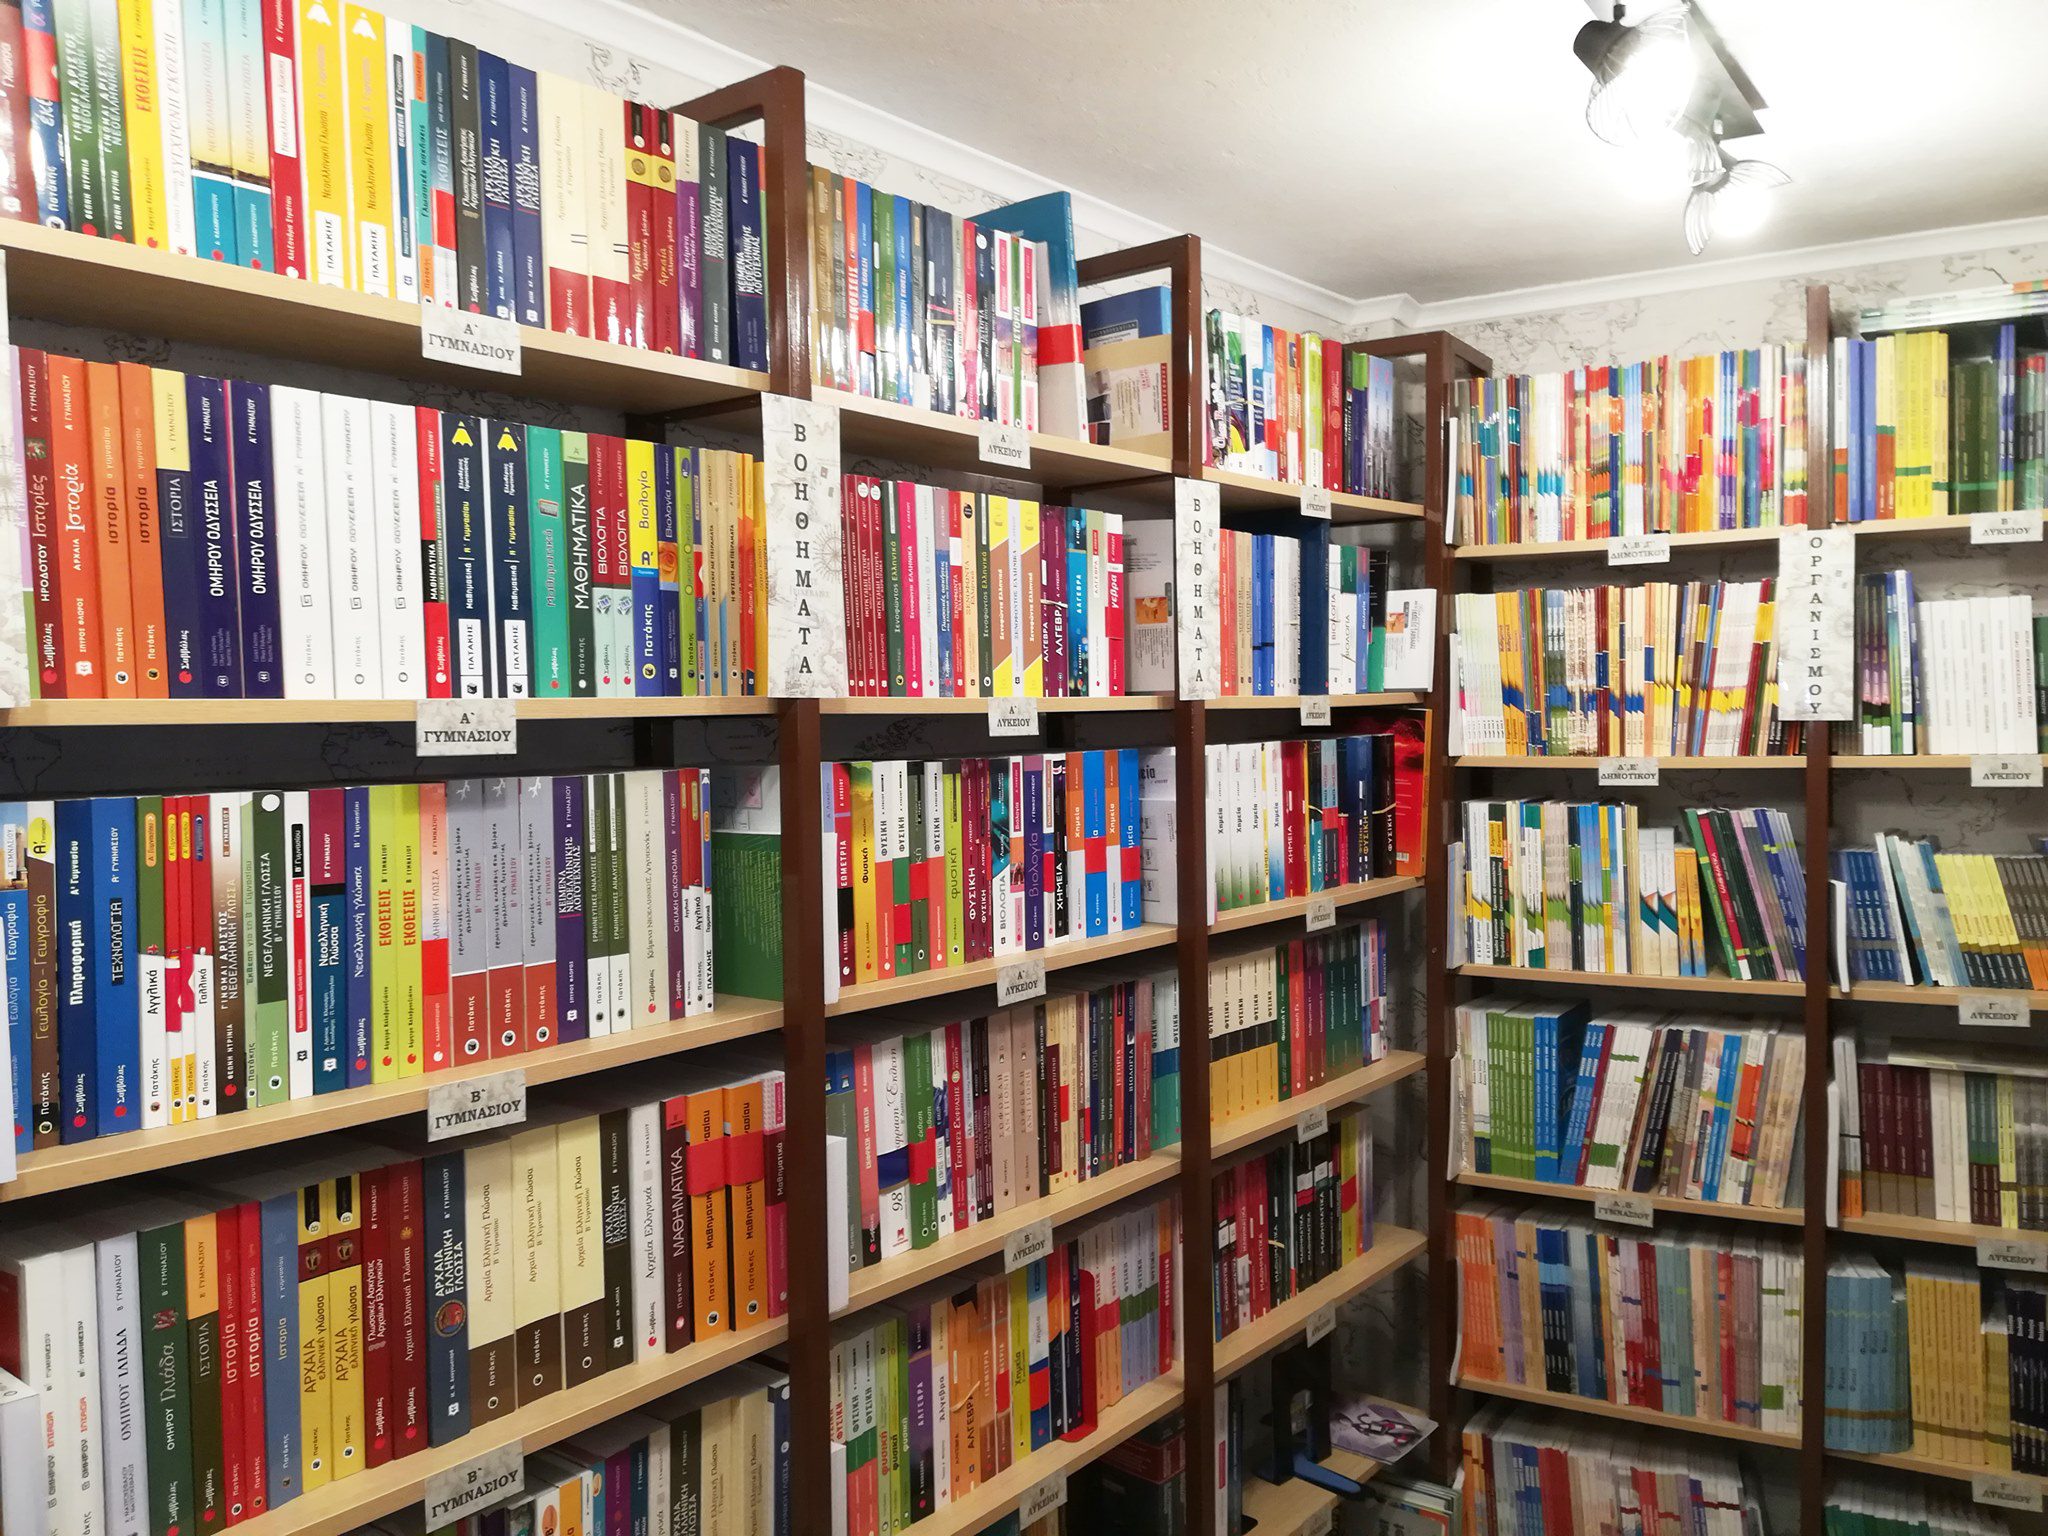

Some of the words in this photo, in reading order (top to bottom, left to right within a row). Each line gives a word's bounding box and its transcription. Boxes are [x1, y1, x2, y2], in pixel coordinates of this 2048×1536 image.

[132, 47, 151, 112] ΕΚΘΕΣΕΙΣ
[323, 219, 334, 269] ΠΑΤΑΚΗΣ
[369, 228, 380, 279] ΠΑΤΑΚΗΣ
[752, 236, 762, 295] ΛΟΓΟΤΕΧΝΙΑΣ
[737, 252, 745, 292] ΚΕΙΜΕΝΑ
[848, 267, 858, 320] ΕΚΘΕΣΕΙΣ
[429, 332, 515, 362] ΓΥΜΝΑΣΙΟΥ
[202, 397, 211, 434] ΓΥΜΝΑΣΙΟΥ
[248, 399, 256, 435] ΓΥΜΝΑΣΙΟΥ
[988, 445, 1022, 459] ΛΥΚΕΙΟΥ
[31, 475, 47, 538] Ιστορίες
[60, 463, 85, 532] Ιστορία
[104, 487, 119, 544] ιστορία
[136, 487, 150, 543] ιστορία
[169, 478, 183, 532] ΙΣΤΟΡΙΑ
[204, 480, 220, 539] ΟΔΥΣΣΕΙΑ
[248, 480, 264, 538] ΟΔΥΣΣΕΙΑ
[638, 470, 650, 528] Βιολογία
[665, 490, 673, 537] Βιολογία
[571, 484, 590, 609] ΜΑΘΗΜΑΤΙΚΑ
[597, 507, 608, 574] ΒΙΟΛΟΓΙΑ
[618, 509, 628, 576] ΒΙΟΛΟΓΙΑ
[794, 423, 812, 674] ΒΟΗΘΗΜΑΤΑ
[1610, 548, 1667, 559] ΔΗΜΟΤΙΚΟΥ
[1982, 526, 2030, 536] ΛΥΚΕΙΟΥ
[38, 544, 50, 601] ΗΡΟΔΟΤΟΥ
[208, 542, 224, 596] ΟΜΗΡΟΥ
[251, 541, 266, 594] ΟΜΗΡΟΥ
[428, 544, 437, 600] ΜΑΘΗΜΑΤΙΚΑ
[889, 540, 899, 581] Ελληνικά
[1193, 498, 1203, 682] ΒΟΗΘΗΜΑΤΑ
[146, 625, 156, 659] Πατάκης
[512, 625, 520, 670] ΠΑΤΑΚΗΣ
[643, 604, 654, 657] Πατάκης
[1808, 537, 1823, 714] ΟΡΓΑΝΙΣΜΟΥ
[578, 638, 586, 674] Πατάκης
[424, 728, 511, 743] ΓΥΜΝΑΣΙΟΥ
[997, 718, 1030, 728] ΛΥΚΕΙΟΥ
[1982, 772, 2032, 781] ΛΥΚΕΙΟΥ
[110, 827, 119, 872] ΓΥΜΝΑΣΙΟΥ
[323, 833, 331, 869] ΓΥΜΝΑΣΙΟΥ
[880, 820, 888, 856] ΦΥΣΙΚΗ
[70, 841, 81, 884] Γυμνασίου
[260, 853, 271, 895] ΓΛΩΣΣΑ
[565, 836, 574, 913] ΝΕΟΕΛΛΗΝΙΚΗΣ
[572, 845, 581, 912] ΛΟΓΟΤΕΧΝΙΑΣ
[948, 848, 960, 900] φυσική
[1028, 832, 1040, 897] Βιολογία
[273, 885, 283, 929] ΓΥΜΝΑΣΙΟΥ
[295, 883, 303, 918] ΕΚΘΕΣΕΙΣ
[352, 866, 365, 909] γλώσσα
[558, 870, 567, 914] ΚΕΙΜΕΝΑ
[968, 867, 977, 920] ΦΥΣΙΚΗ
[998, 875, 1006, 930] ΒΙΟΛΟΓΙΑ
[5, 903, 18, 961] Γεωγραφία
[34, 895, 48, 965] Γεωγραφία
[219, 911, 228, 961] ΑΡΙΣΤΟΣ
[262, 898, 273, 977] ΝΕΟΕΛΛΗΝΙΚΗ
[318, 903, 330, 966] Νεοελληνική
[378, 889, 391, 946] ΕΚΘΕΣΕΙΣ
[403, 889, 416, 946] ΕΚΘΕΣΕΙΣ
[591, 892, 599, 942] ΕΡΜΗΝΕΥΤΙΚΕΣ
[672, 900, 680, 932] ΟΙΚΙΑΚΗ
[69, 920, 83, 1005] Πληροφορική
[110, 902, 123, 981] ΤΕΧΝΟΛΟΓΙΑ
[227, 922, 238, 999] ΝΕΟΕΛΛΗΝΙΚΗ
[328, 926, 339, 965] Γλώσσα
[353, 913, 366, 978] Νεοελληνική
[36, 979, 49, 1040] Γεωλογία
[145, 970, 160, 1015] Αγγλικά
[197, 968, 208, 1005] Γαλλικά
[220, 964, 229, 1010] ΓΙΝΟΜΑΙ
[503, 989, 512, 1023] Πατάκης
[1005, 980, 1038, 997] ΛΥΚΕΙΟΥ
[466, 996, 476, 1032] Πατάκης
[1970, 1010, 2019, 1021] ΛΥΚΕΙΟΥ
[270, 1030, 280, 1068] Πατάκης
[40, 1072, 50, 1115] Πατάκης
[150, 1058, 160, 1097] Πατάκης
[435, 1100, 521, 1128] ΓΥΜΝΑΣΙΟΥ
[776, 1142, 785, 1196] Μαθηματικά
[481, 1184, 491, 1220] Γλώσσα
[643, 1186, 655, 1237] Ελληνικά
[671, 1147, 685, 1257] ΜΑΘΗΜΑΤΙΚΑ
[891, 1192, 903, 1211] 98
[402, 1246, 412, 1282] Γλώσσα
[443, 1229, 454, 1294] ΕΛΛΗΝΙΚΗ
[454, 1241, 464, 1291] ΓΛΩΣΣΑ
[482, 1223, 493, 1267] Ελληνική
[645, 1240, 656, 1279] Αρχαία
[1012, 1243, 1045, 1263] ΛΥΚΕΙΟΥ
[1988, 1254, 2036, 1265] ΛΥΚΕΙΟΥ
[366, 1260, 377, 1299] Ασκήσεις
[435, 1249, 445, 1297] ΑΡΧΑΙΑ
[482, 1270, 494, 1302] Αρχαία
[708, 1260, 716, 1302] Πατάκης
[317, 1295, 328, 1334] γλώσσα
[368, 1301, 378, 1341] Γλωσσικές
[402, 1285, 413, 1326] Ελληνική
[116, 1328, 128, 1377] ΙΛΙΑΔΑ
[199, 1322, 211, 1377] ΙΣΤΟΡΙΑ
[277, 1318, 291, 1360] Ιστορία
[403, 1329, 415, 1361] Αρχαία
[532, 1329, 543, 1364] Πατάκης
[1073, 1309, 1081, 1354] ΒΙΟΛΟΓΙΑ
[159, 1342, 178, 1402] Ιλιάδα
[303, 1339, 317, 1393] ΑΡΧΑΙΑ
[317, 1337, 328, 1380] ελληνική
[119, 1382, 131, 1441] ΟΜΗΡΟΥ
[851, 1394, 860, 1433] ΦΥΣΙΚΗ
[917, 1381, 925, 1426] ΑΛΓΕΒΡΑ
[165, 1408, 176, 1450] ΟΜΗΡΟΥ
[432, 1470, 518, 1518] ΓΥΜΝΑΣΙΟΥ
